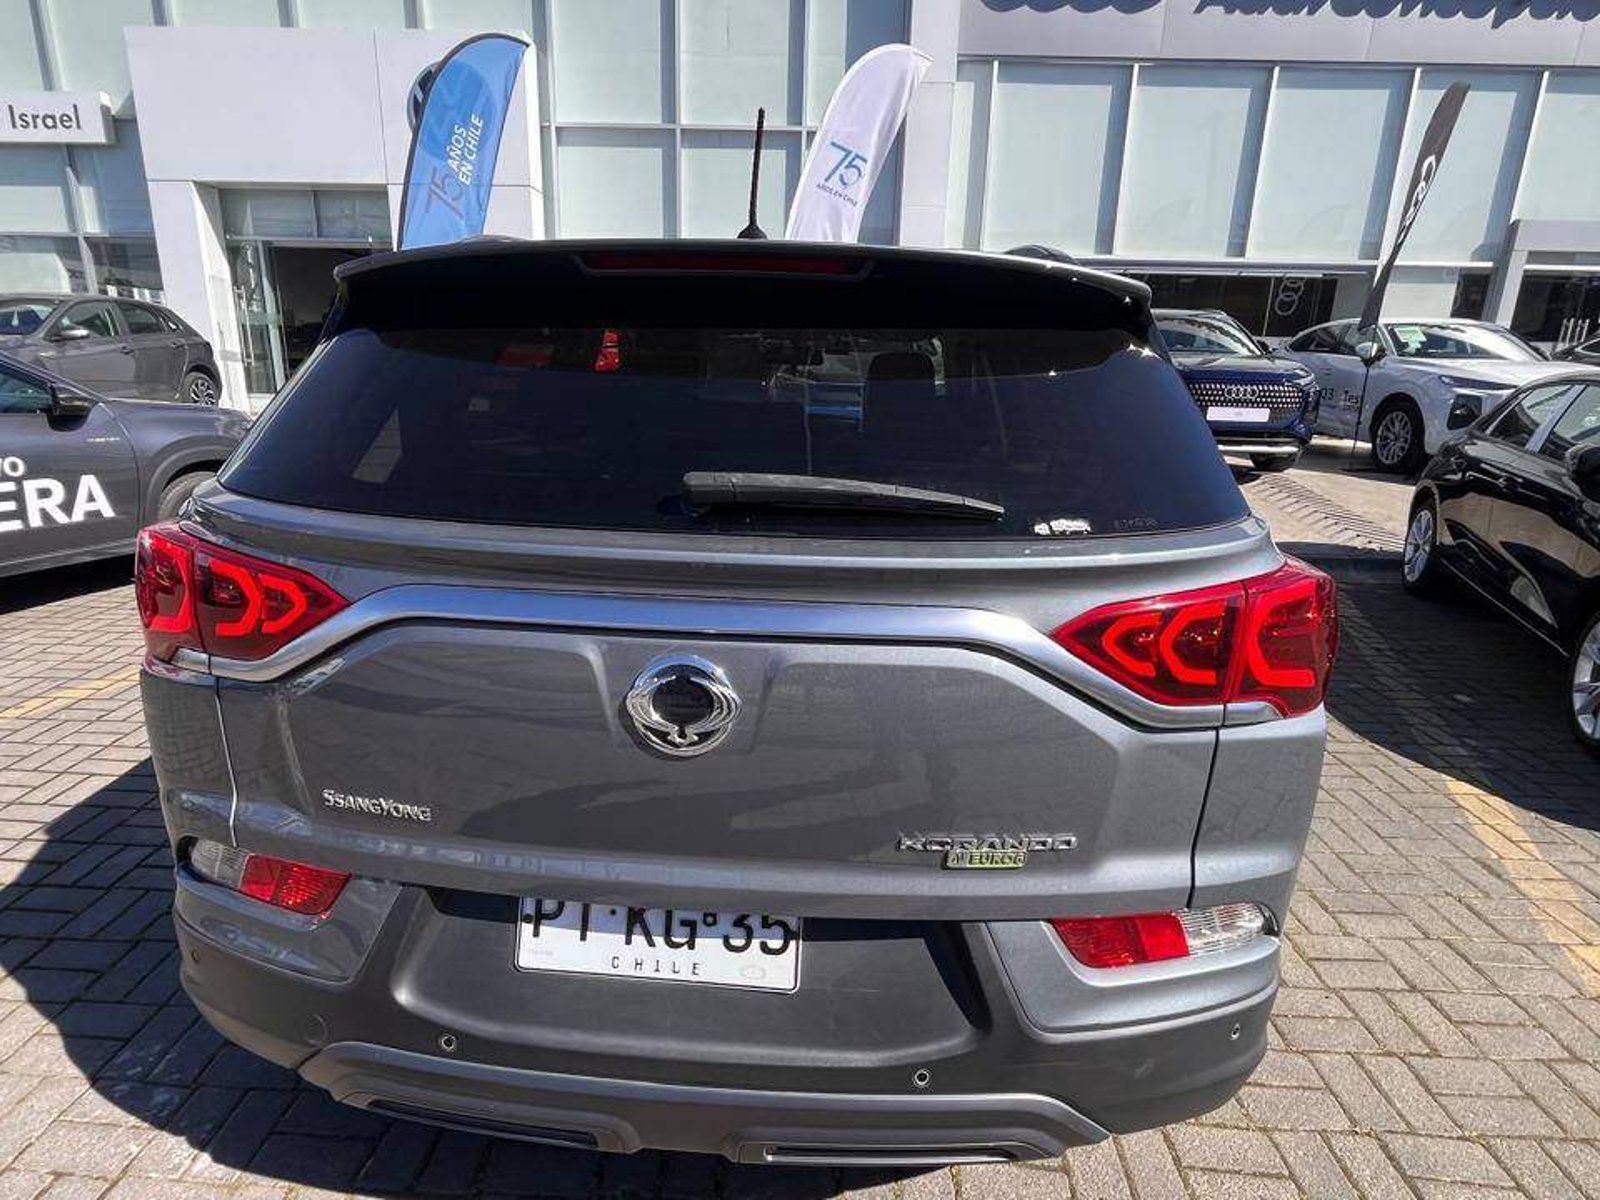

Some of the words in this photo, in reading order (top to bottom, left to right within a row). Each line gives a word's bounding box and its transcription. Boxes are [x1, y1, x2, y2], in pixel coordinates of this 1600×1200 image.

[7, 103, 82, 130] Israel
[446, 124, 467, 173] AÑOS
[463, 113, 484, 160] CHILE
[459, 160, 474, 186] EN
[824, 141, 868, 186] 75
[897, 832, 1077, 851] KORANDO
[611, 955, 705, 976] CHILE
